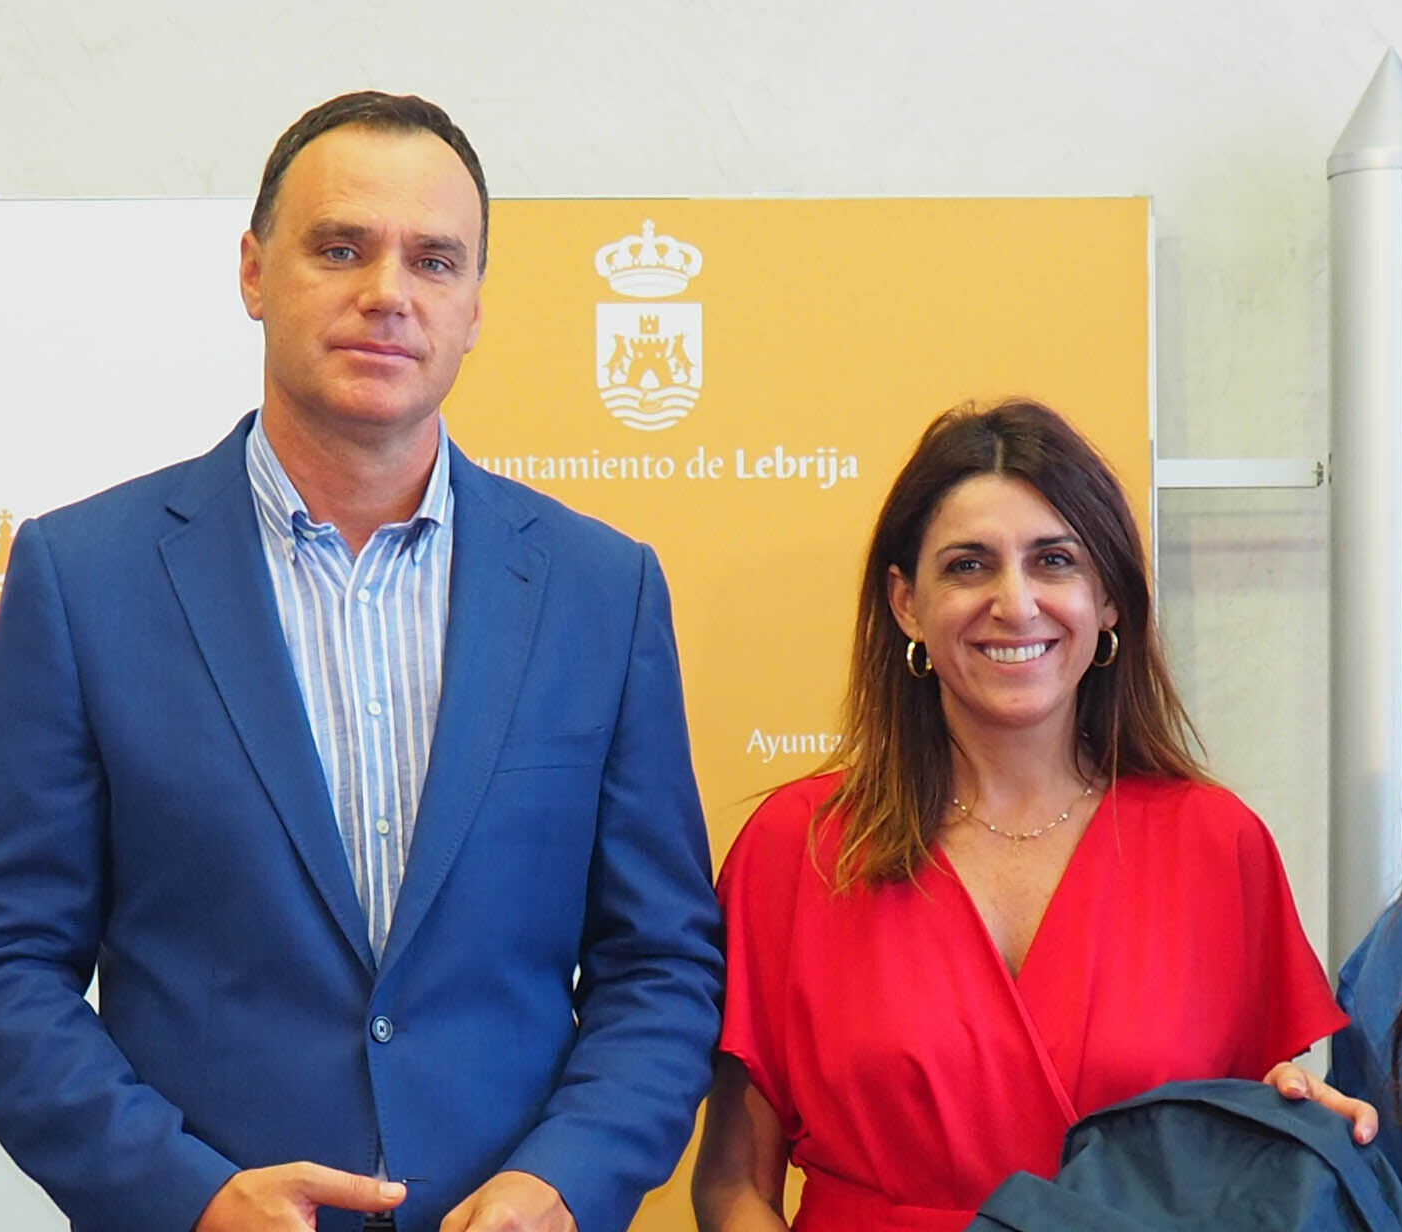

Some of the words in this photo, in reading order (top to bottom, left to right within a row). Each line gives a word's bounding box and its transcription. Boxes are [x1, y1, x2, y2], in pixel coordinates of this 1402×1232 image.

[476, 449, 674, 480] untamiento
[685, 446, 725, 478] de
[735, 447, 859, 490] Lebrija
[746, 728, 842, 763] Ayunta
